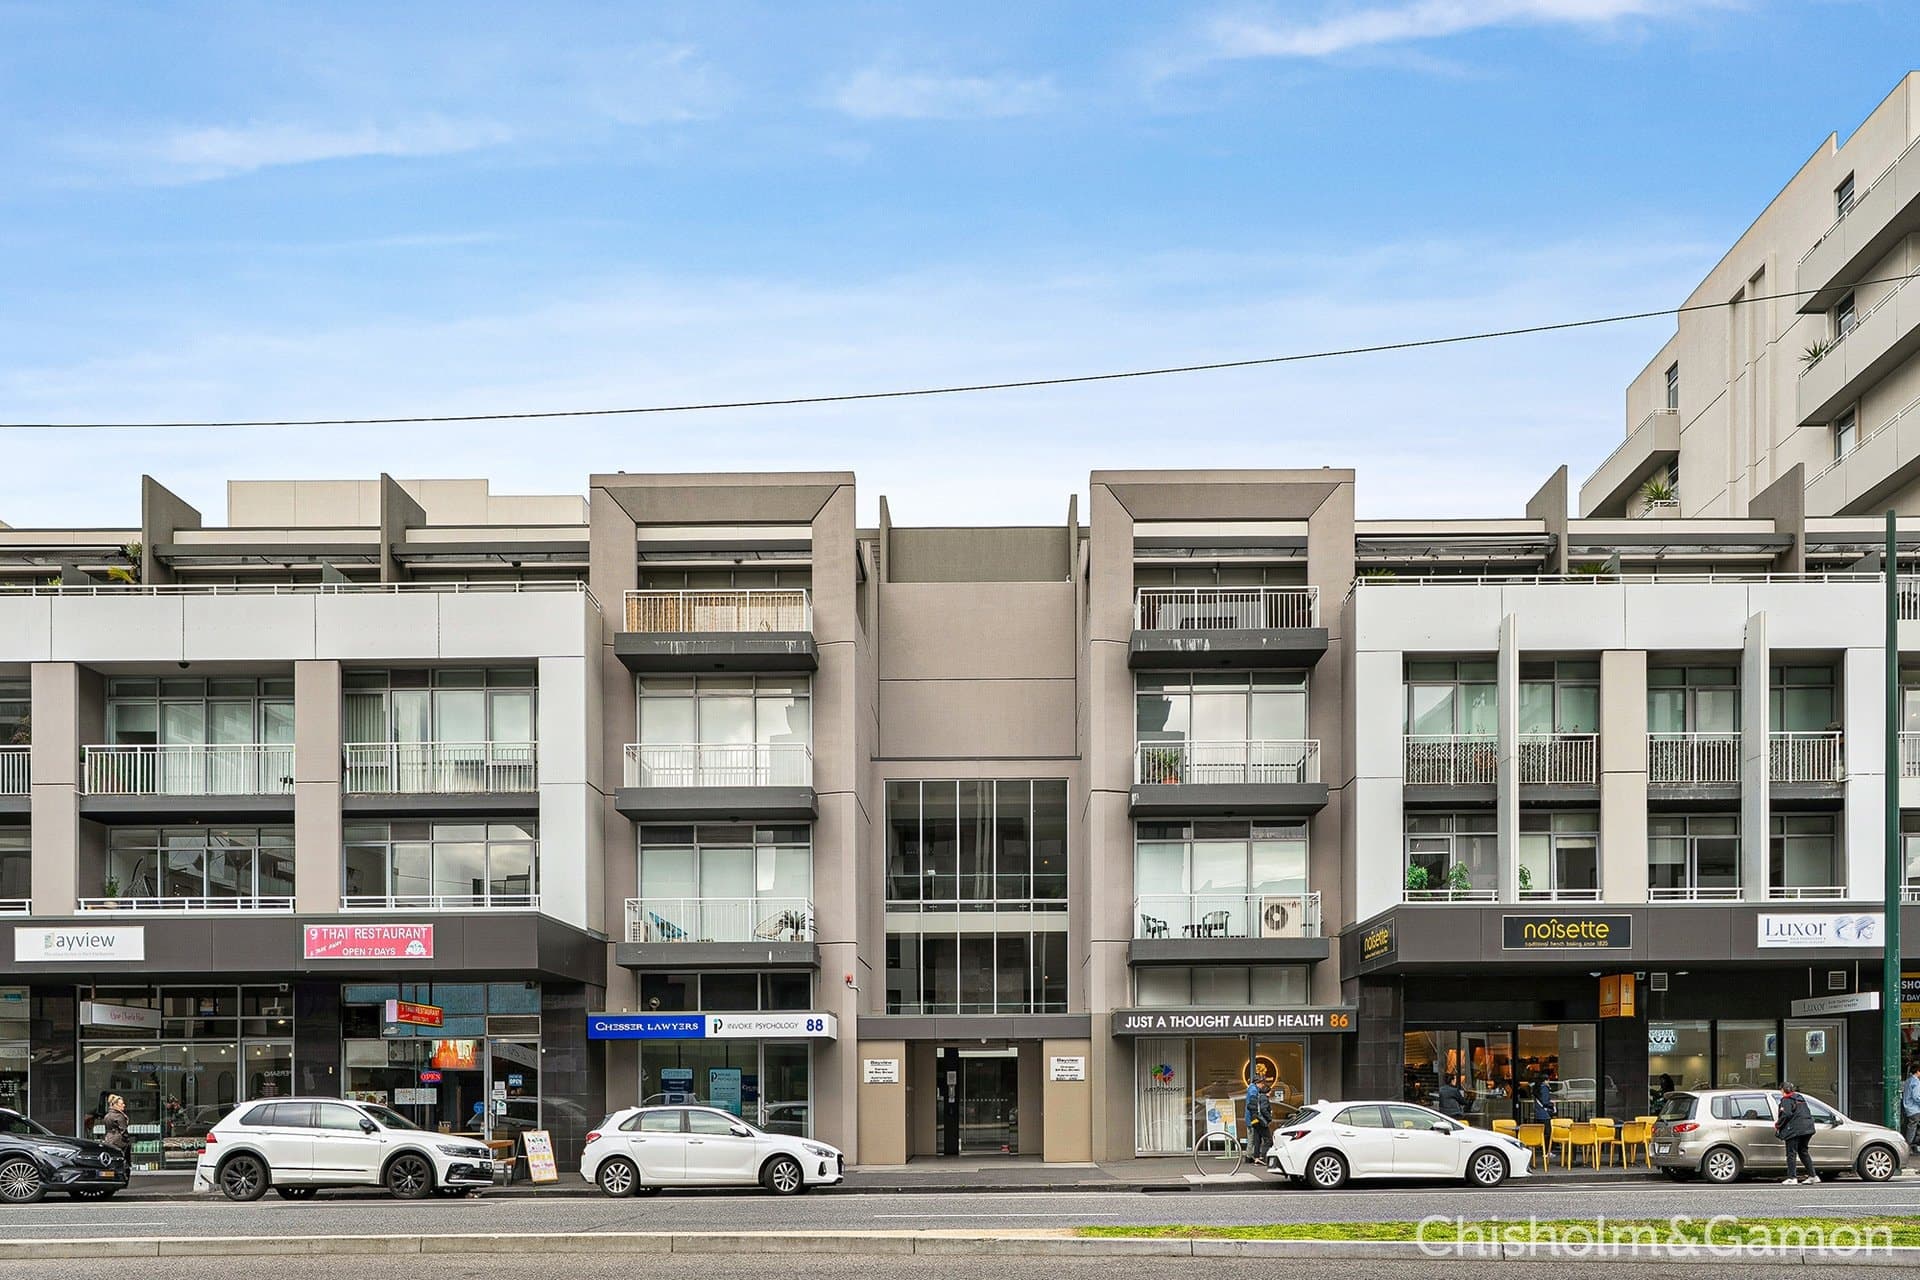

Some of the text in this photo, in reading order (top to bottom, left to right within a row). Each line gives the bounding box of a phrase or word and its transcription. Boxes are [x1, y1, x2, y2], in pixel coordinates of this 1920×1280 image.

[1524, 919, 1609, 938] noîsette
[1766, 918, 1827, 936] Luxor
[310, 928, 428, 940] 9 THAI RESTAURANT
[342, 947, 396, 956] OPEN 7 DAYS
[755, 1022, 799, 1030] PSYCHOLOGY
[806, 1019, 823, 1031] 88
[1125, 1014, 1348, 1028] JUST A THOUGHT ALLIED HEALTH 86
[420, 1071, 441, 1081] OPEN
